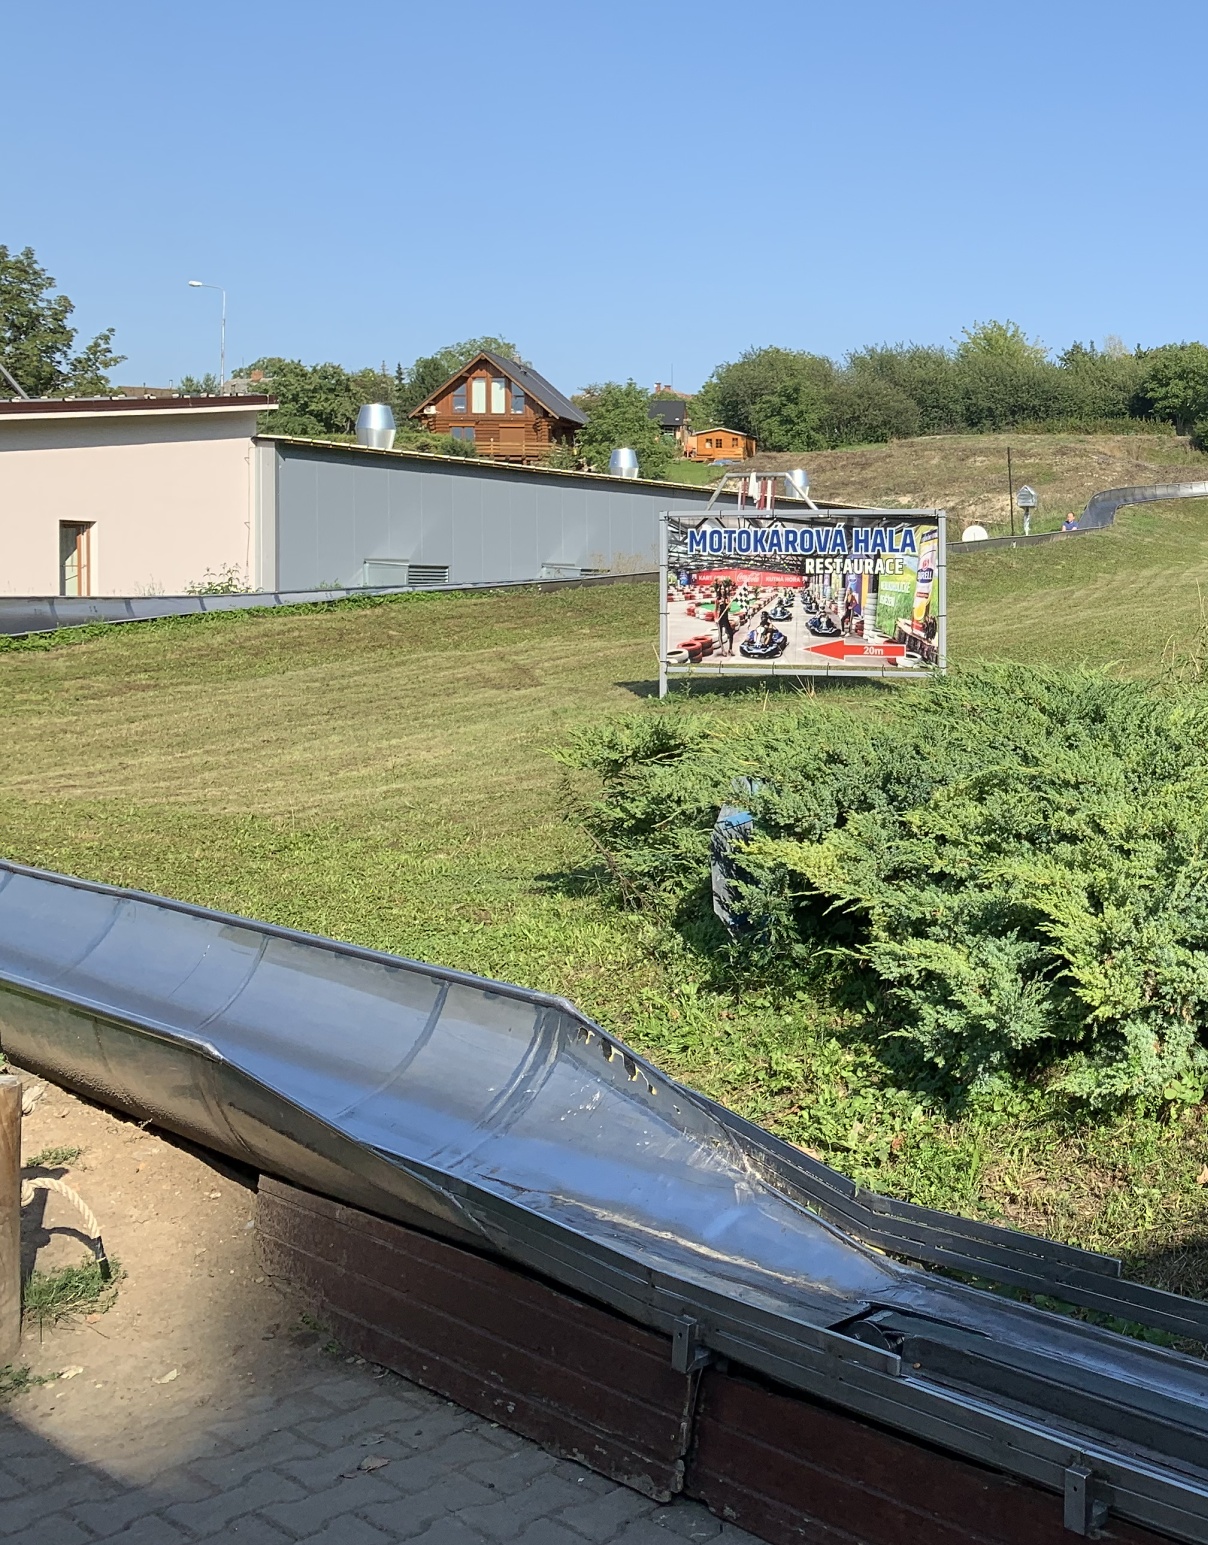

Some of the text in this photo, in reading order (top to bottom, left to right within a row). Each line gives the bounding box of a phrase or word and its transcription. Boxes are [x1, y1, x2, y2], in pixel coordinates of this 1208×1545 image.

[687, 523, 848, 554] MOTOKÁROVÁ
[853, 528, 917, 554] HALA
[805, 558, 904, 575] RESTAURACE
[863, 646, 884, 655] 20m
